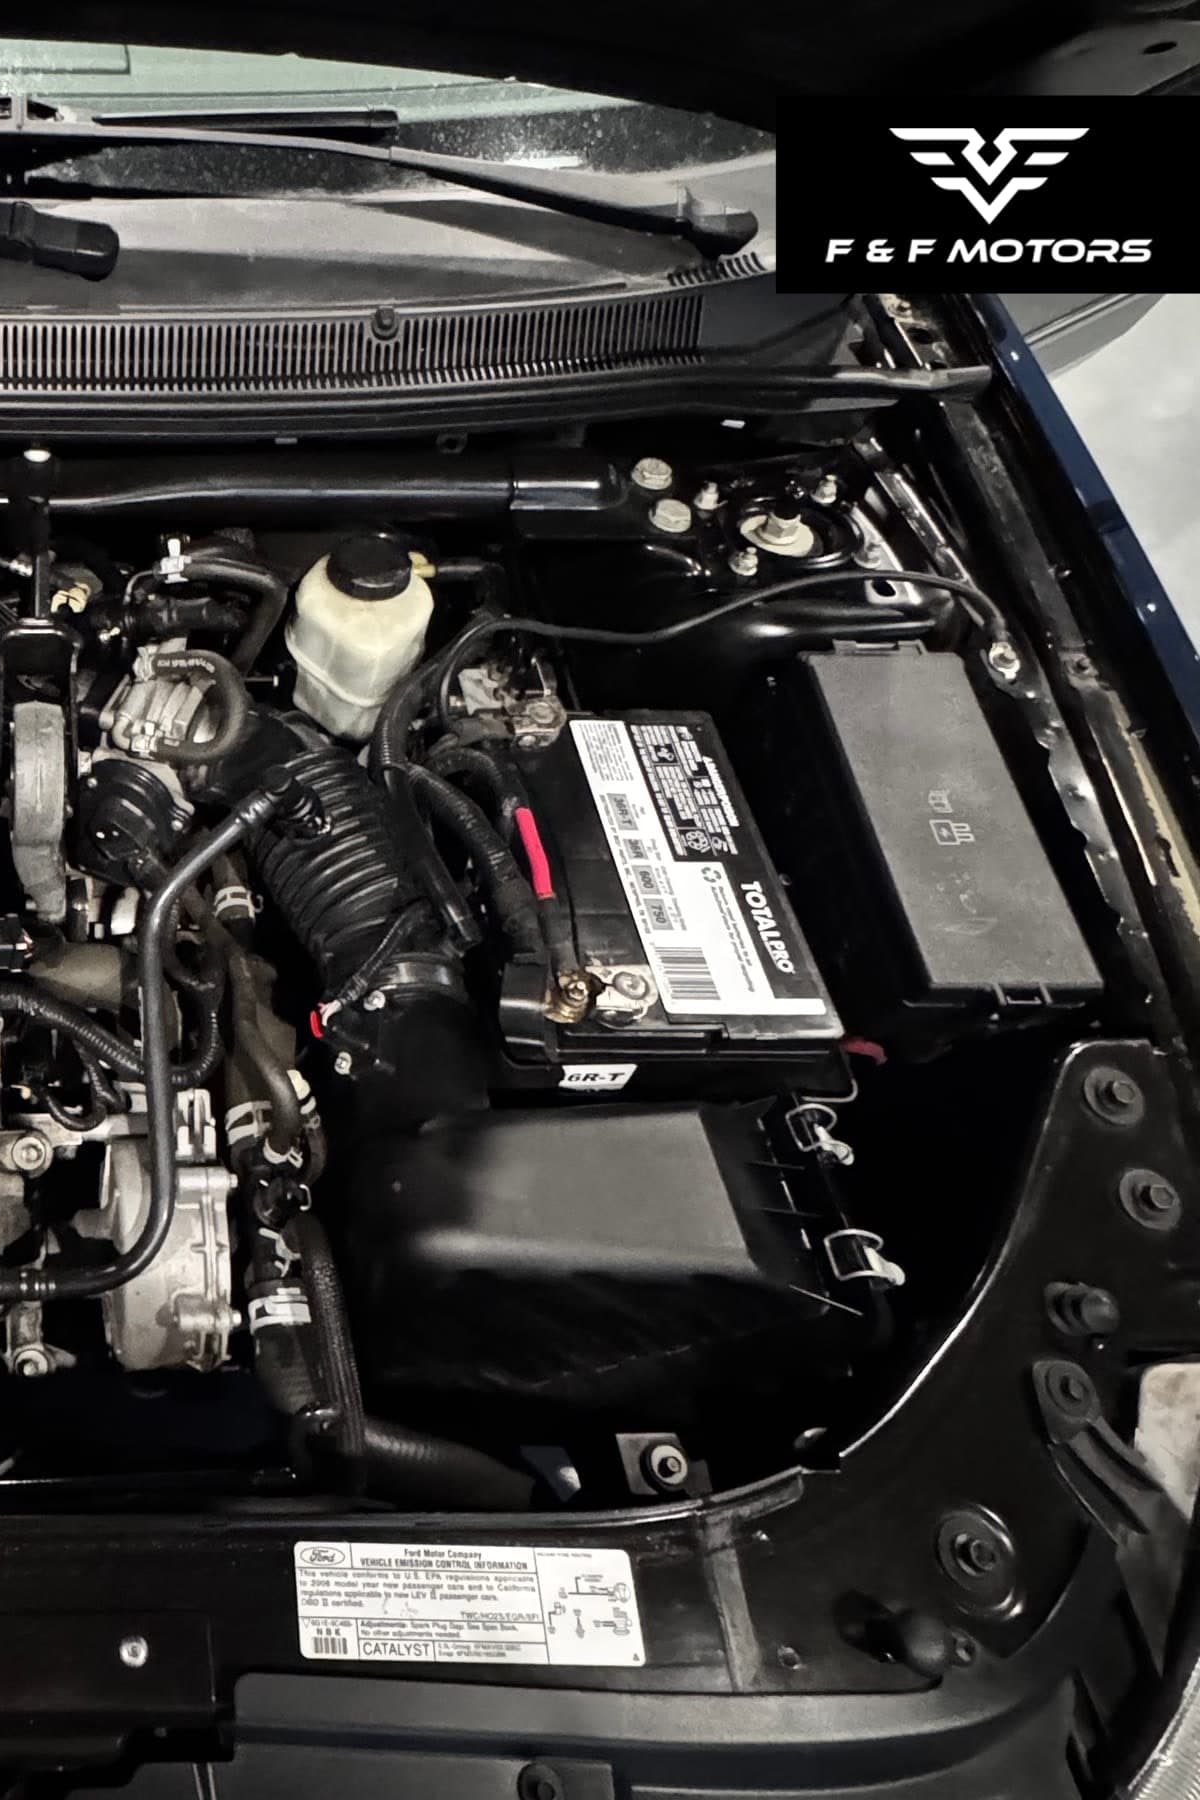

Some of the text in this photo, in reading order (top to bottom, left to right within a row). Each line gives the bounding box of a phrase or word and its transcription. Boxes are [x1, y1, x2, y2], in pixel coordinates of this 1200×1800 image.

[639, 870, 653, 889] 600
[650, 904, 666, 923] 750
[739, 880, 795, 972] TOTALPRO
[309, 1549, 336, 1563] Ford
[404, 1548, 482, 1560] Ford Motor Company
[360, 1557, 528, 1570] VEHICLE EMISSION CONTROL INFORMATION
[363, 1642, 430, 1657] CATALYST
